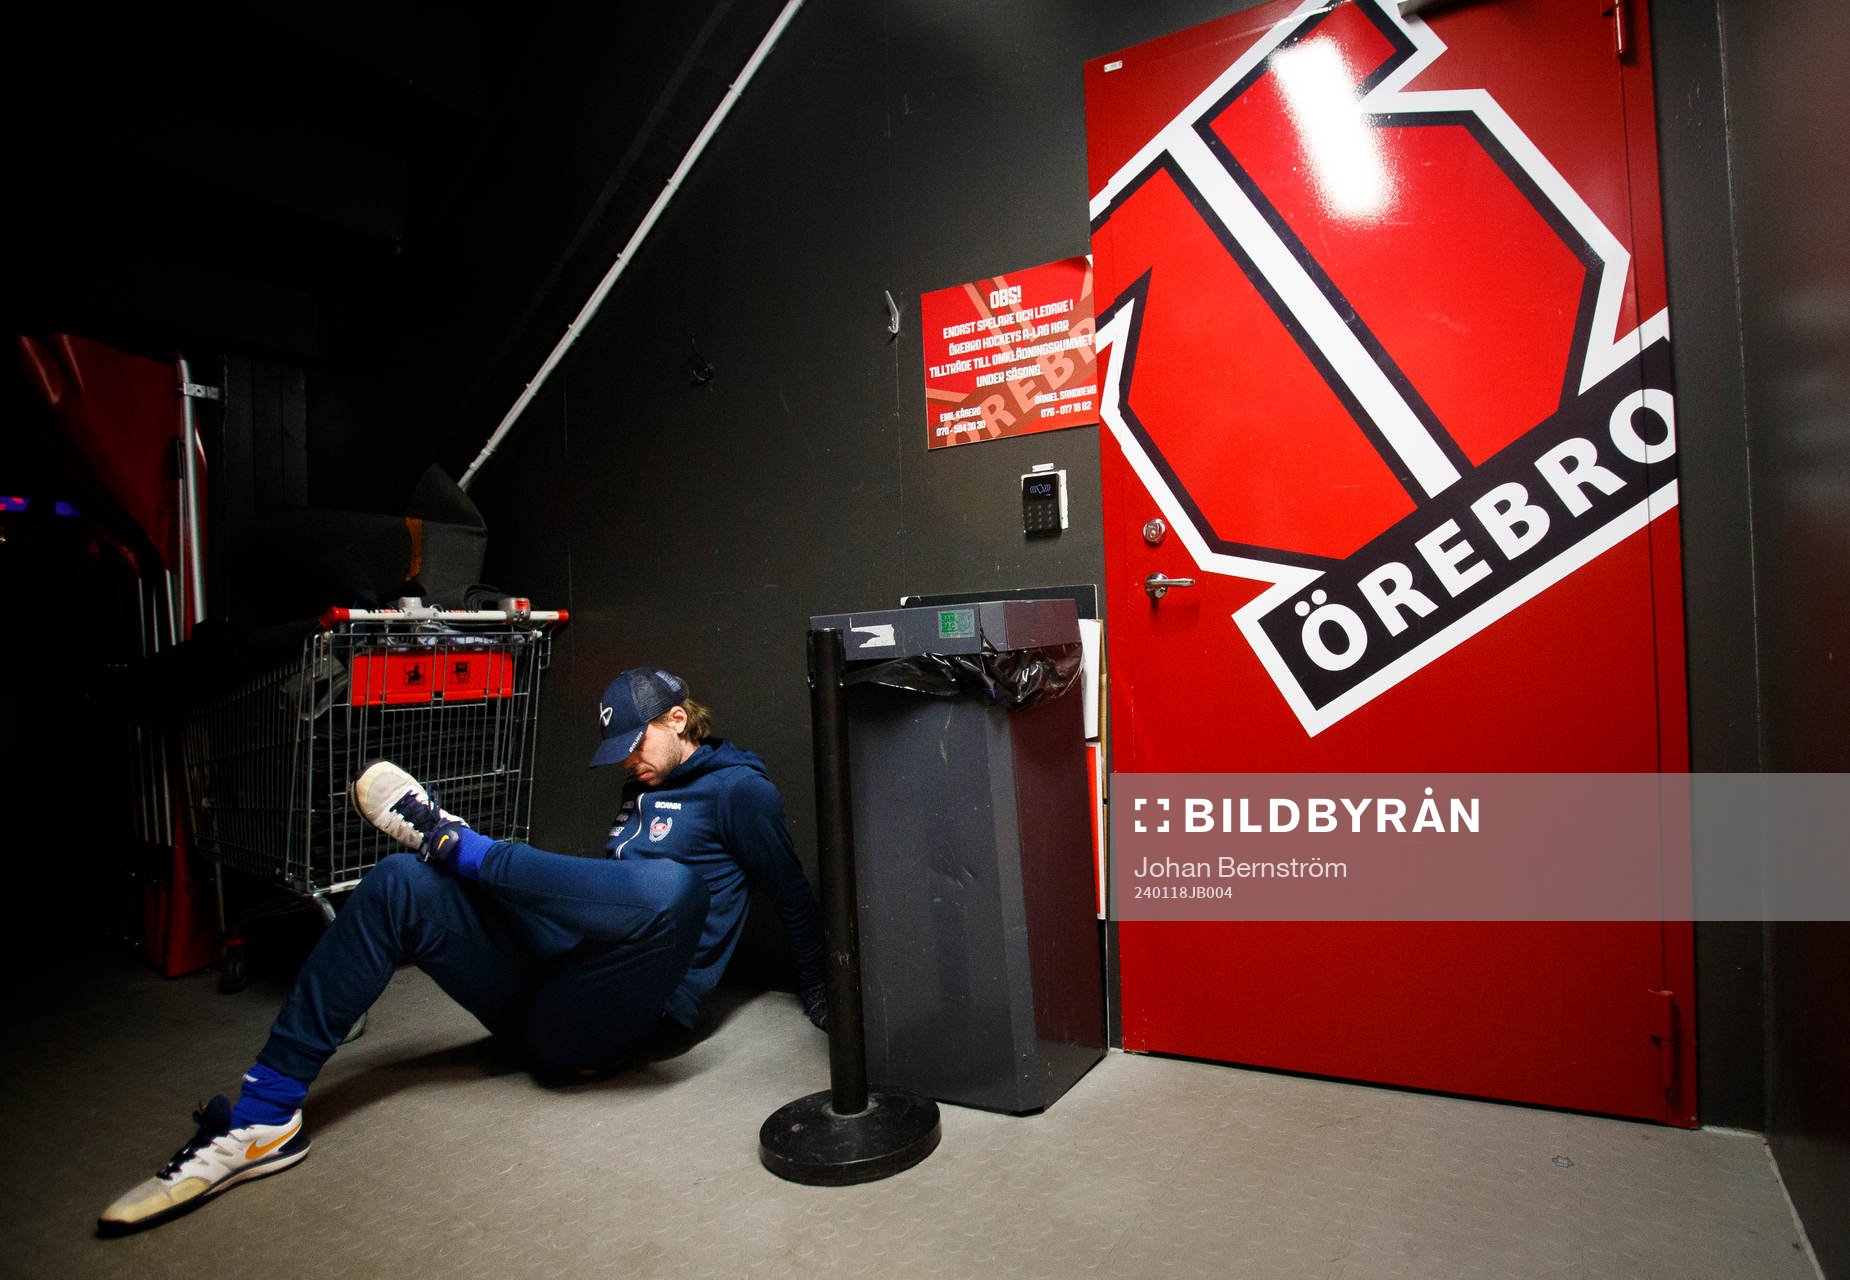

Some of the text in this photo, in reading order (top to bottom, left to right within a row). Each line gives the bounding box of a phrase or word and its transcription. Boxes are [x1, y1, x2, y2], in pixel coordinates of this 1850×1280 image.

[989, 285, 1022, 309] OBS!
[943, 321, 975, 339] ENDAST
[977, 313, 1014, 333] SPELARE
[1016, 309, 1034, 325] OCH
[1035, 302, 1069, 320] LEDARE
[948, 320, 1069, 356] ÖREBRO HOCKEYS A-LAG HAR
[929, 334, 1094, 378] TILLTRÄDE TILL OMKLÄDNINGSRUMMET
[976, 371, 1004, 387] UNDER
[1035, 391, 1059, 404] DANIEL
[1295, 387, 1677, 671] ÖREBRO
